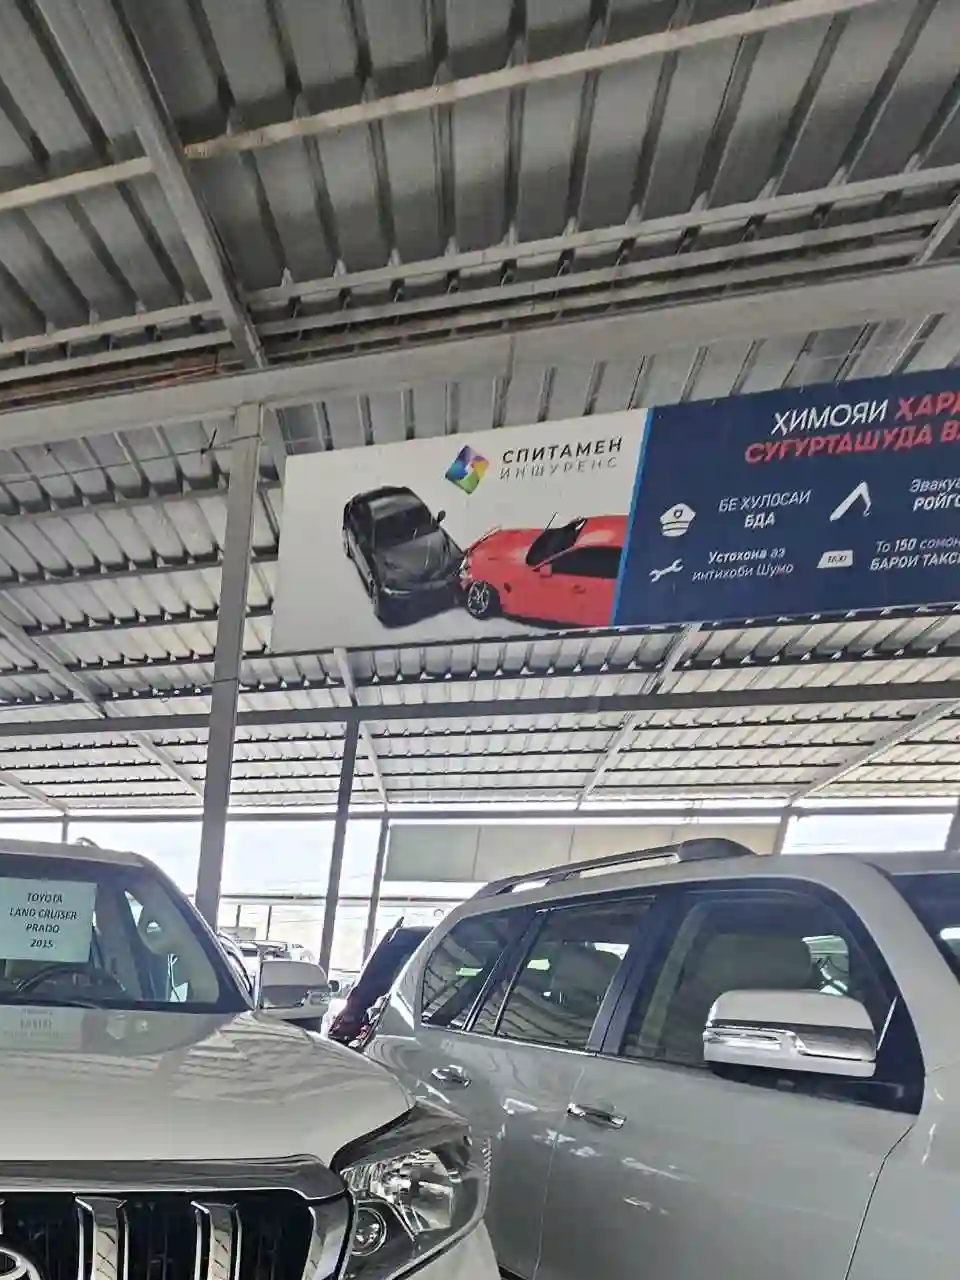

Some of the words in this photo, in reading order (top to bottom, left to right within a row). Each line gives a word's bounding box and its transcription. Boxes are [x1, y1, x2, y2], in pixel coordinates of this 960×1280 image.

[502, 436, 623, 464] СПИТАМЕН
[500, 457, 618, 481] ИНШУРЕНС
[718, 495, 739, 513] БЕ
[740, 488, 813, 510] ХУЛОСАИ
[744, 511, 776, 529] БДА
[894, 538, 918, 553] 150
[756, 562, 794, 579] Шумо
[869, 554, 919, 571] БАРОИ
[27, 892, 63, 903] TOYOTA
[9, 907, 36, 917] LAND
[38, 908, 77, 920] CRUISER
[26, 923, 60, 934] PRADO
[30, 939, 54, 949] 2015
